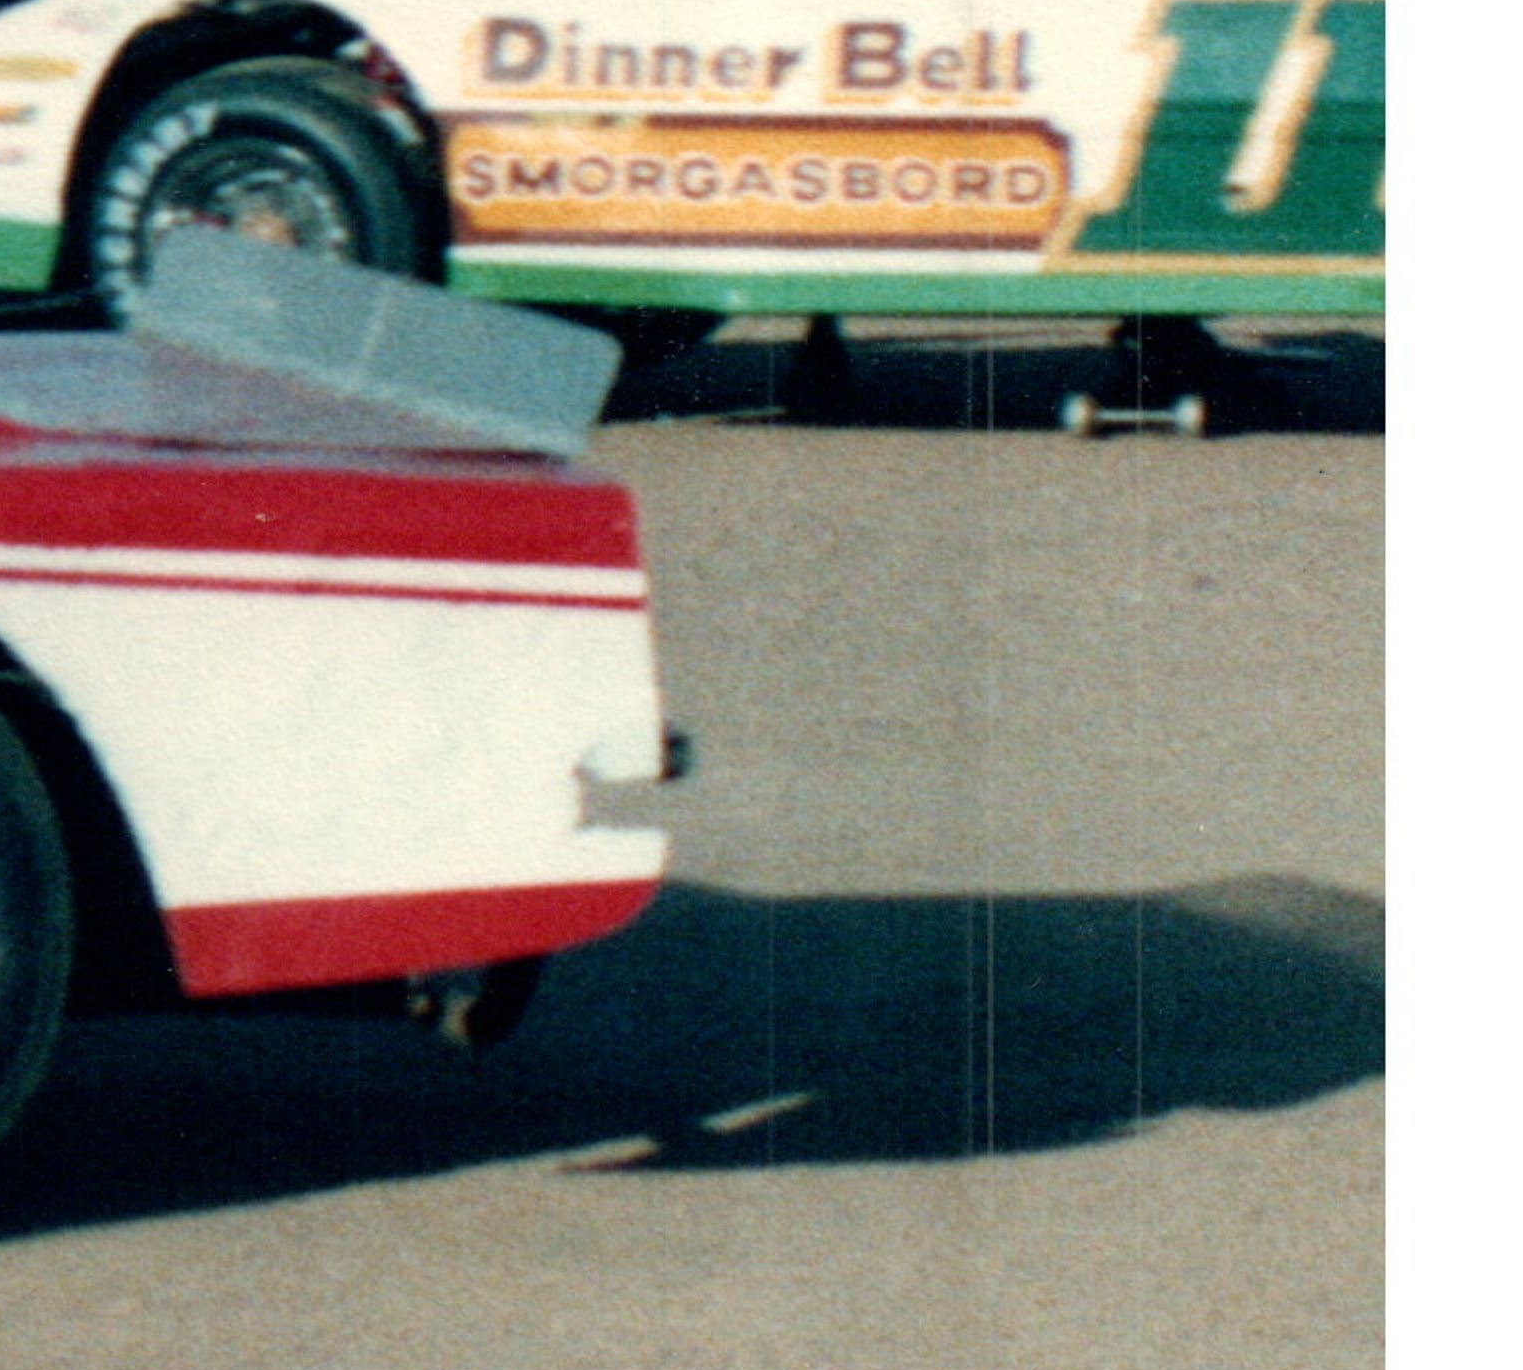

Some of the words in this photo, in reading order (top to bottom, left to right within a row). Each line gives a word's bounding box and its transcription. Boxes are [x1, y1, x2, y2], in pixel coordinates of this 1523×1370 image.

[471, 16, 805, 95] Dinner
[827, 21, 1033, 97] Bell
[461, 153, 1050, 202] SMORGASBORD
